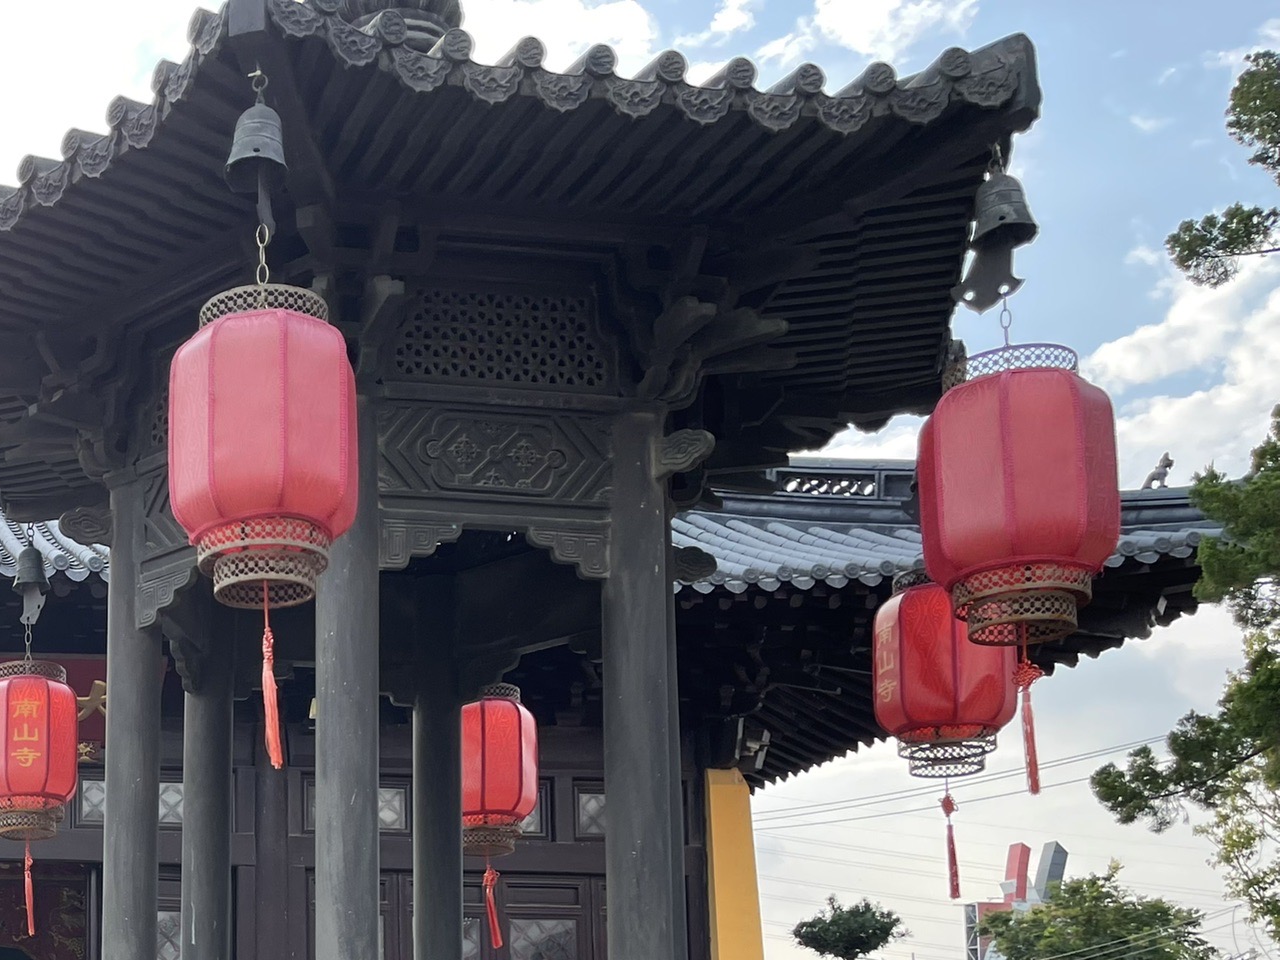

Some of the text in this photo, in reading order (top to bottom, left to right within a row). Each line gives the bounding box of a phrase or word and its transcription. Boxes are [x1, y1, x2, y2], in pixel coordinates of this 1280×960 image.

[878, 622, 897, 702] 南山寺
[11, 698, 42, 768] 南山寺
